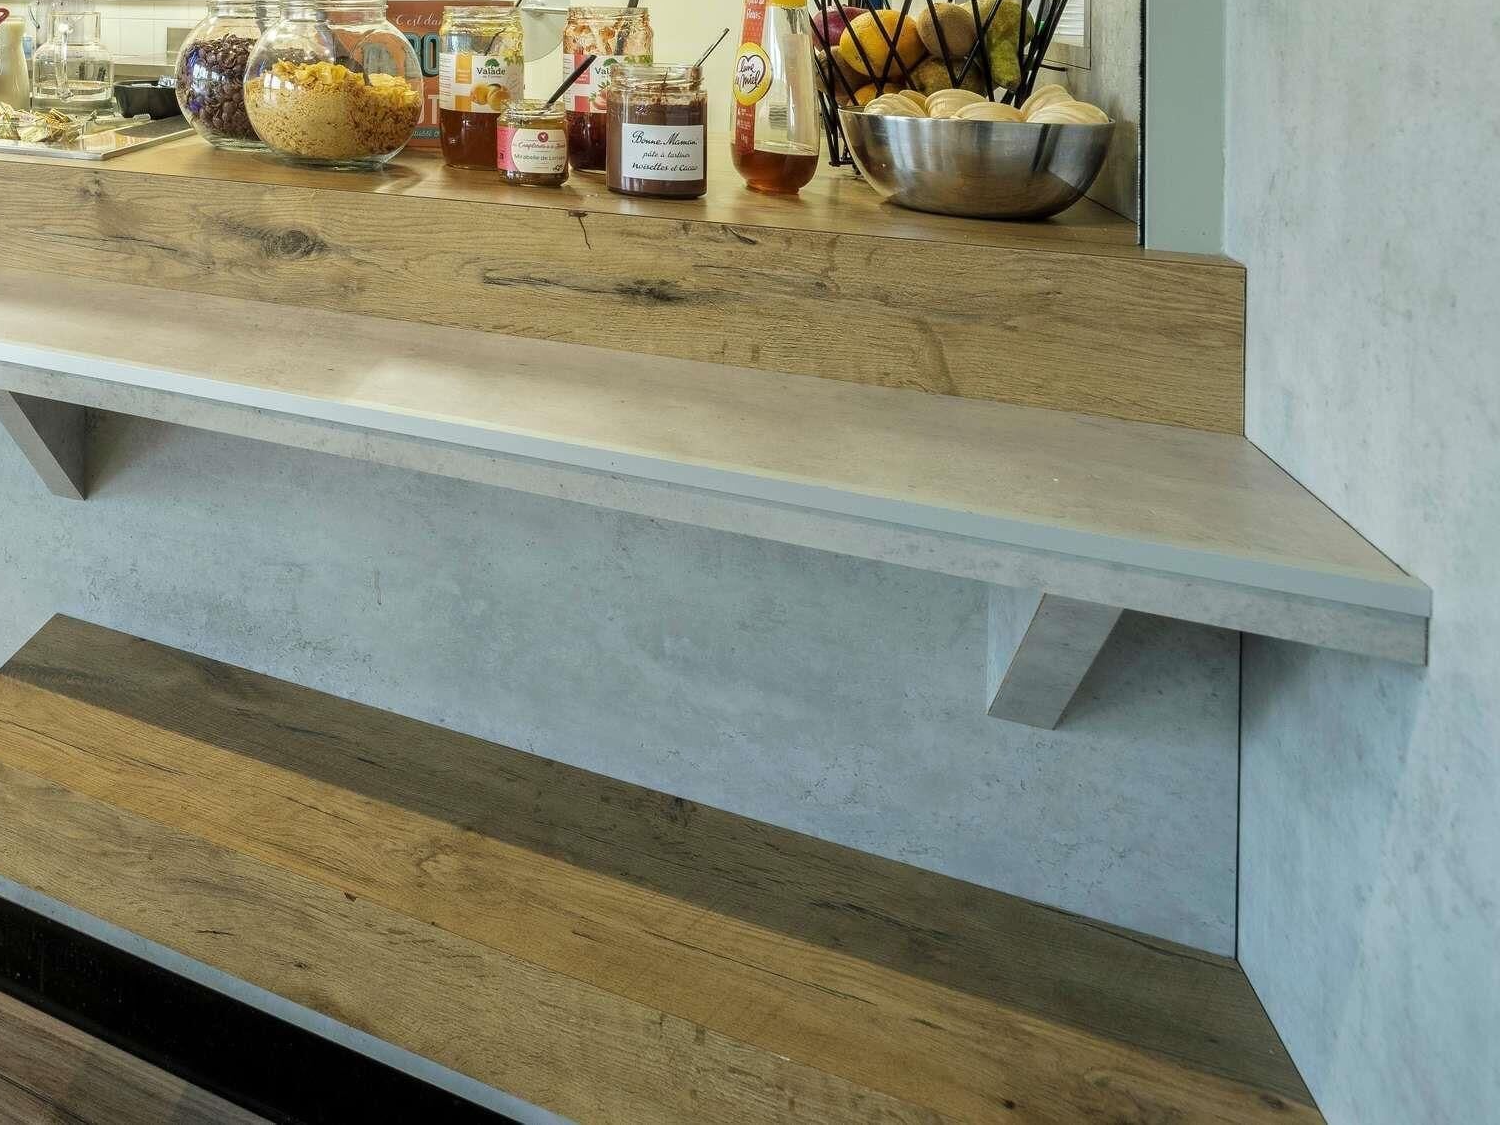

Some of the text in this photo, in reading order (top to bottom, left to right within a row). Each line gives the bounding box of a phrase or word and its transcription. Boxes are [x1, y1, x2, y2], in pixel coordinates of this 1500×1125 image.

[476, 67, 506, 75] Valade
[632, 130, 698, 146] Bonne Maman
